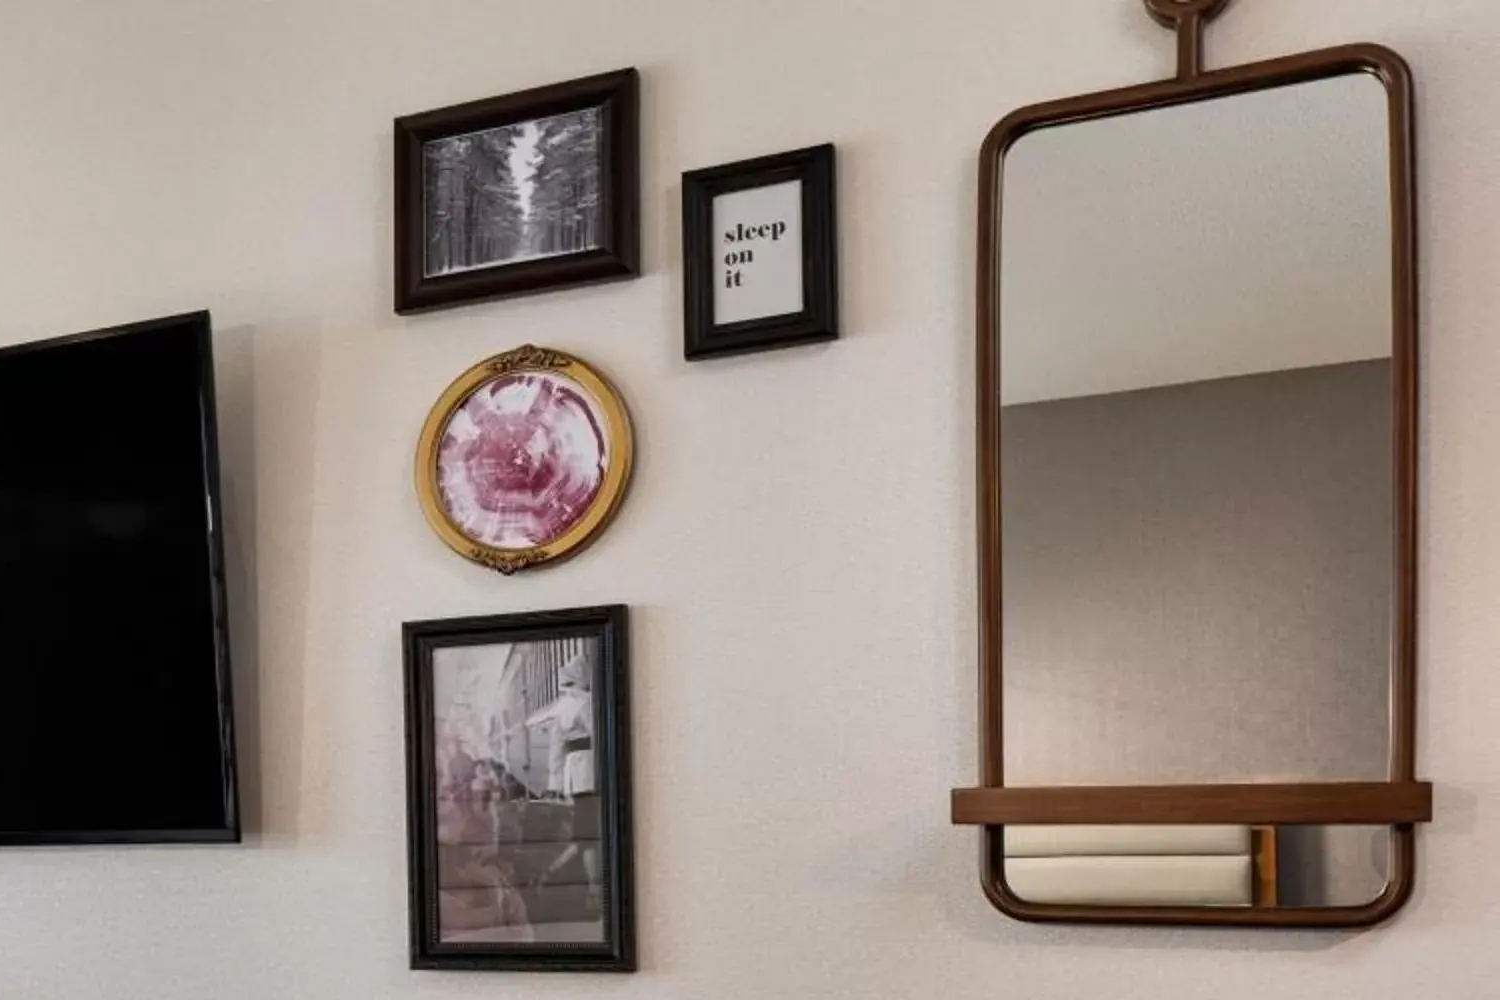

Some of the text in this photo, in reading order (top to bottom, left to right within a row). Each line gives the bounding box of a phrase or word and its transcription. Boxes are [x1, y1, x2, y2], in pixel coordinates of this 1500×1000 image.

[724, 220, 787, 243] sleep
[723, 249, 754, 266] on
[725, 269, 742, 288] it
